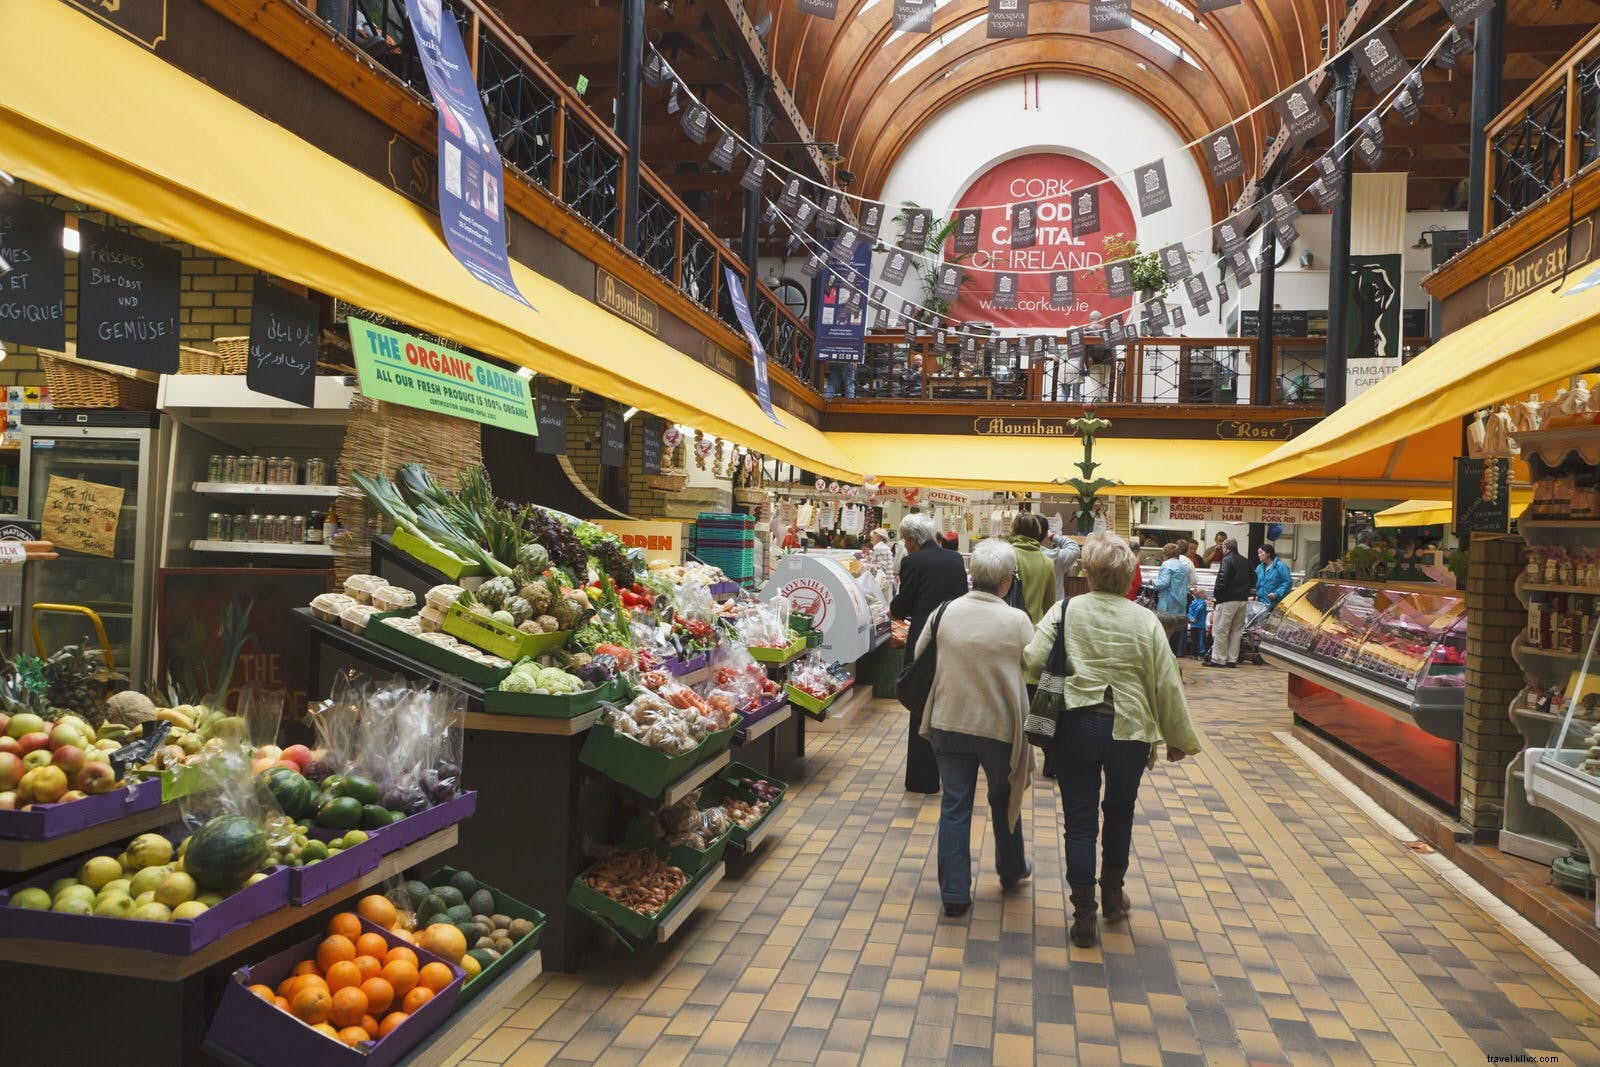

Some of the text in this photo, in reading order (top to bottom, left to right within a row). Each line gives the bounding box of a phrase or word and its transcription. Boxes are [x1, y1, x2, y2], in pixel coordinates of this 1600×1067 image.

[1010, 179, 1073, 198] CORK
[1006, 203, 1072, 222] FOD
[972, 250, 1102, 269] OF IRELAND
[10, 273, 29, 290] ET
[118, 297, 138, 307] UND
[603, 275, 653, 329] Moynihan
[366, 330, 524, 398] THE ORGANIC GARDEN
[376, 368, 393, 383] ALL
[395, 373, 414, 388] OUR
[417, 379, 441, 395] FRESH
[443, 386, 476, 403] PRODUCE
[476, 395, 483, 406] IS
[484, 397, 502, 411] 100%
[503, 403, 528, 419] ORGANIC
[988, 420, 1275, 438] Moynihan Rose
[60, 486, 96, 502] THE TILL
[1240, 498, 1270, 507] BACON
[78, 503, 94, 512] THE
[1169, 504, 1212, 512] SAUSAGES
[1169, 512, 1204, 520] PUDDING
